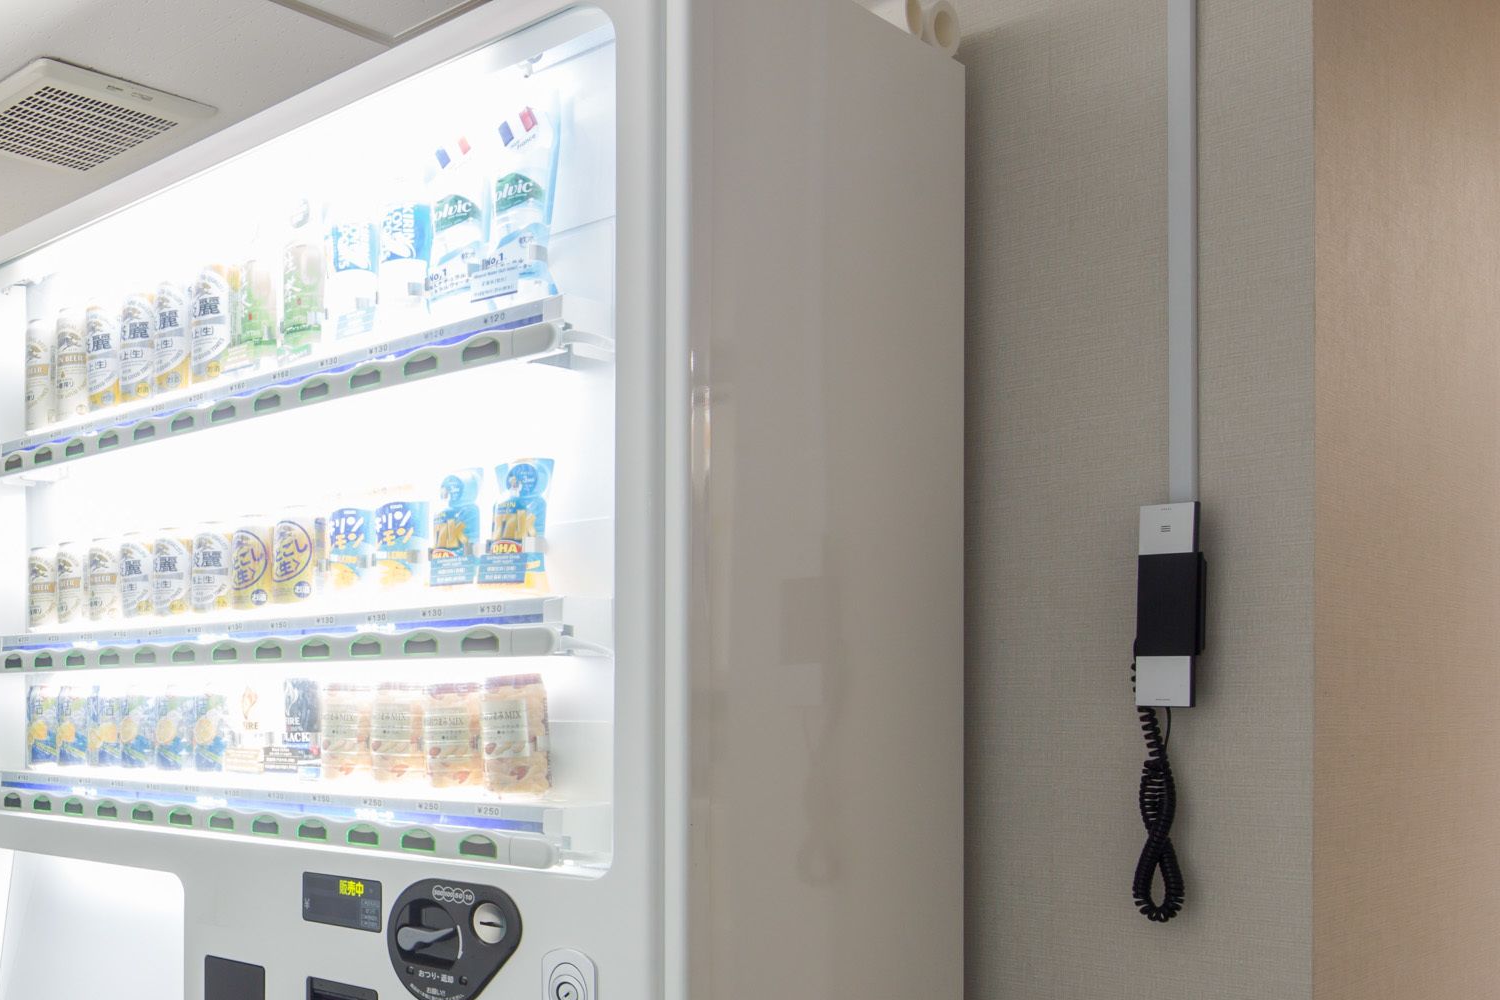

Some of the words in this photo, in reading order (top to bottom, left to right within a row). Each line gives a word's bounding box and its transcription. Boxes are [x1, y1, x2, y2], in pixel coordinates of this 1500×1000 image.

[484, 312, 505, 324] ¥120
[369, 343, 388, 354] ¥130
[320, 357, 338, 367] ¥130
[422, 609, 442, 618] ¥130
[480, 604, 502, 614] ¥130
[316, 616, 334, 625] ¥130
[367, 613, 386, 622] ¥130
[362, 798, 382, 808] ¥250
[418, 801, 439, 811] ¥250
[477, 806, 500, 816] ¥250
[339, 879, 364, 897] 販売中
